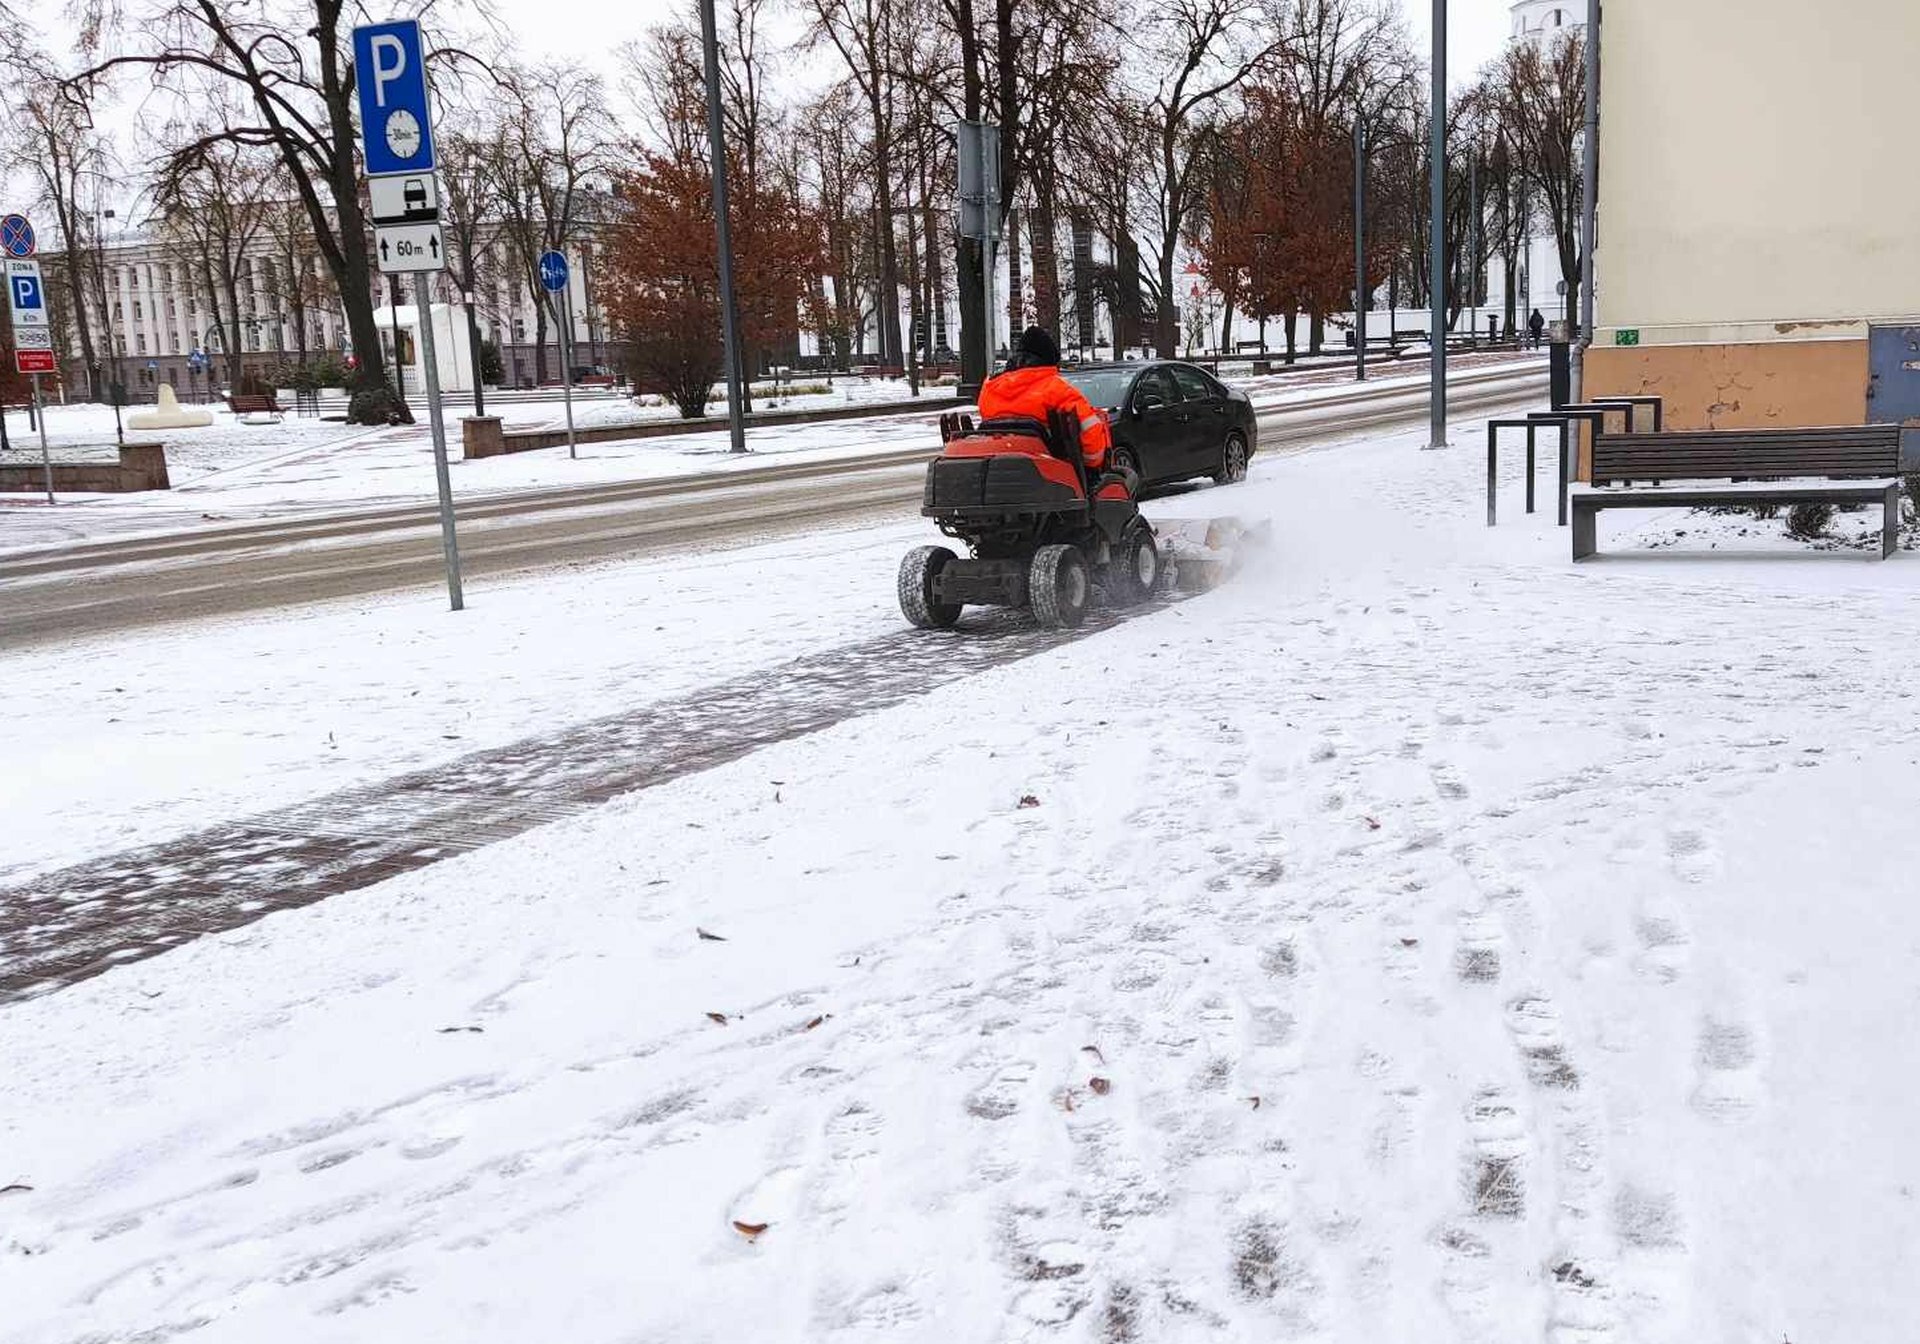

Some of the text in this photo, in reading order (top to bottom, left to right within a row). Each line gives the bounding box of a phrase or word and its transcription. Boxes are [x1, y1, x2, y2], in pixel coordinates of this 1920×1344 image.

[370, 34, 406, 107] P
[397, 240, 423, 256] 60 m
[17, 279, 33, 306] P
